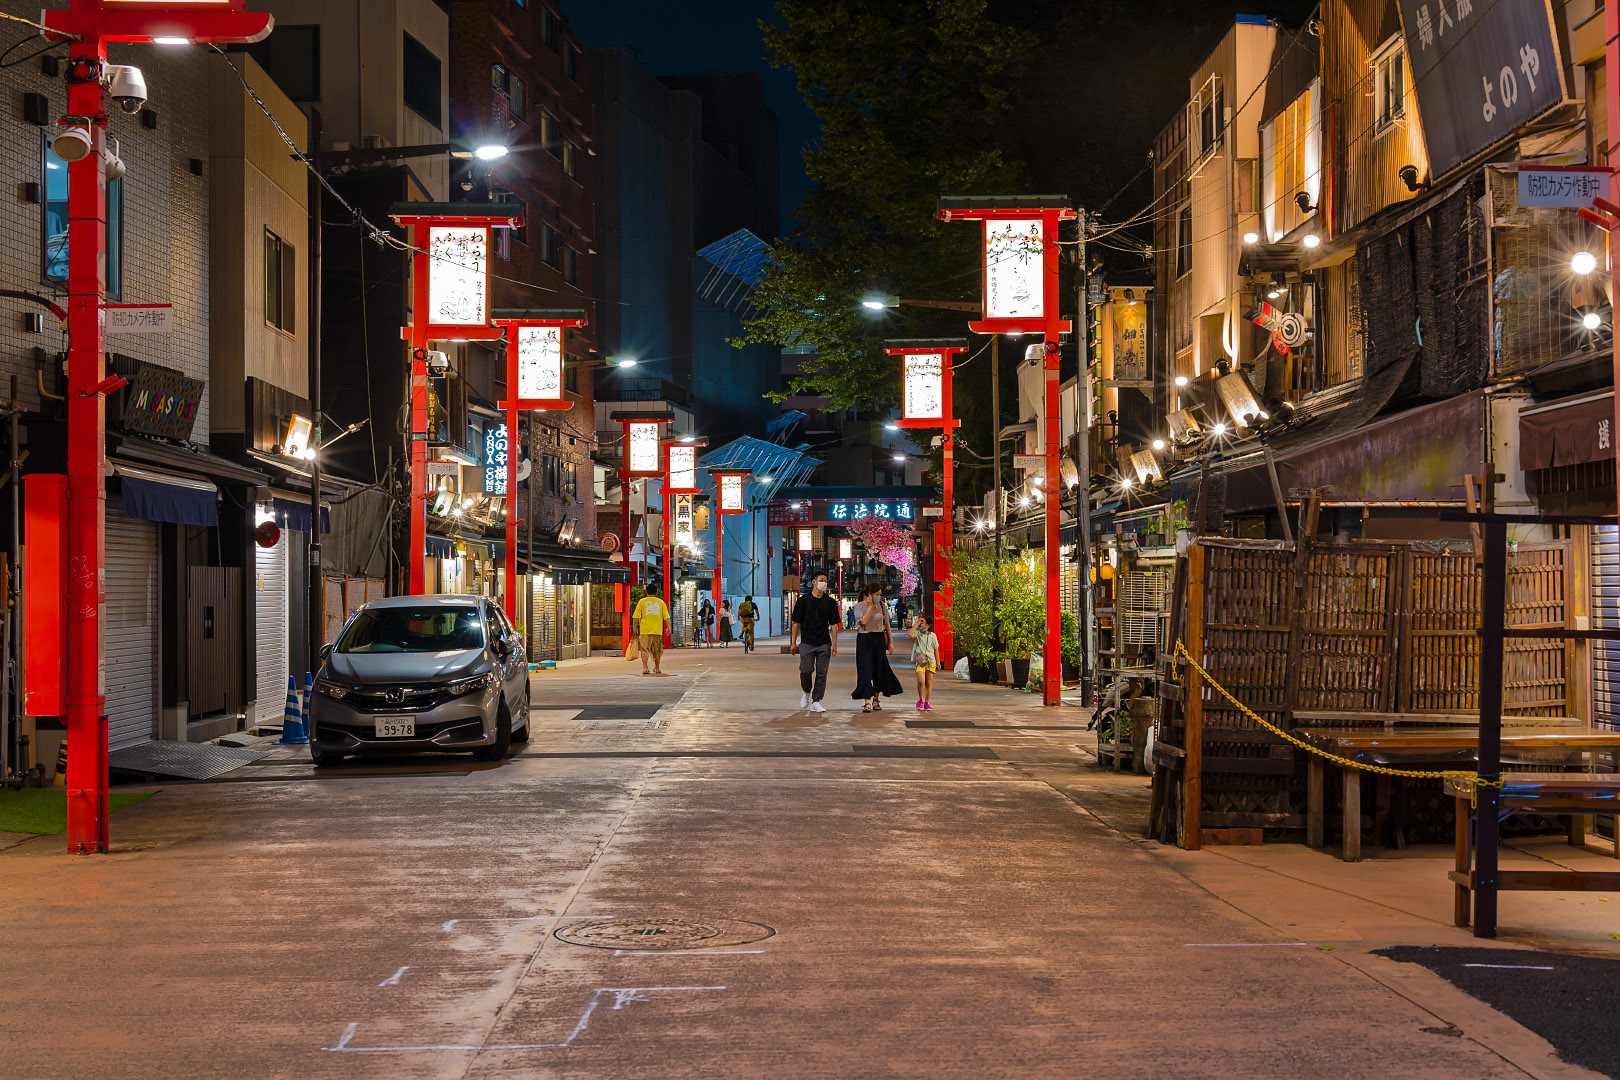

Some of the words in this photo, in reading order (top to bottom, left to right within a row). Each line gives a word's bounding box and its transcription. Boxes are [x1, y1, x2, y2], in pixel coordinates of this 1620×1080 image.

[1482, 42, 1540, 122] よのや
[1528, 174, 1601, 198] 防犯カメラ作動中
[470, 231, 483, 272] わらう
[112, 310, 166, 327] 防犯カメラ作動中
[1122, 328, 1138, 366] 佃煮
[486, 429, 495, 464] YONOYA
[1598, 419, 1610, 450] 浅
[486, 467, 495, 492] COMB
[677, 494, 691, 533] 大黒家
[832, 502, 911, 519] 伝法院通
[384, 724, 413, 736] 99-78
